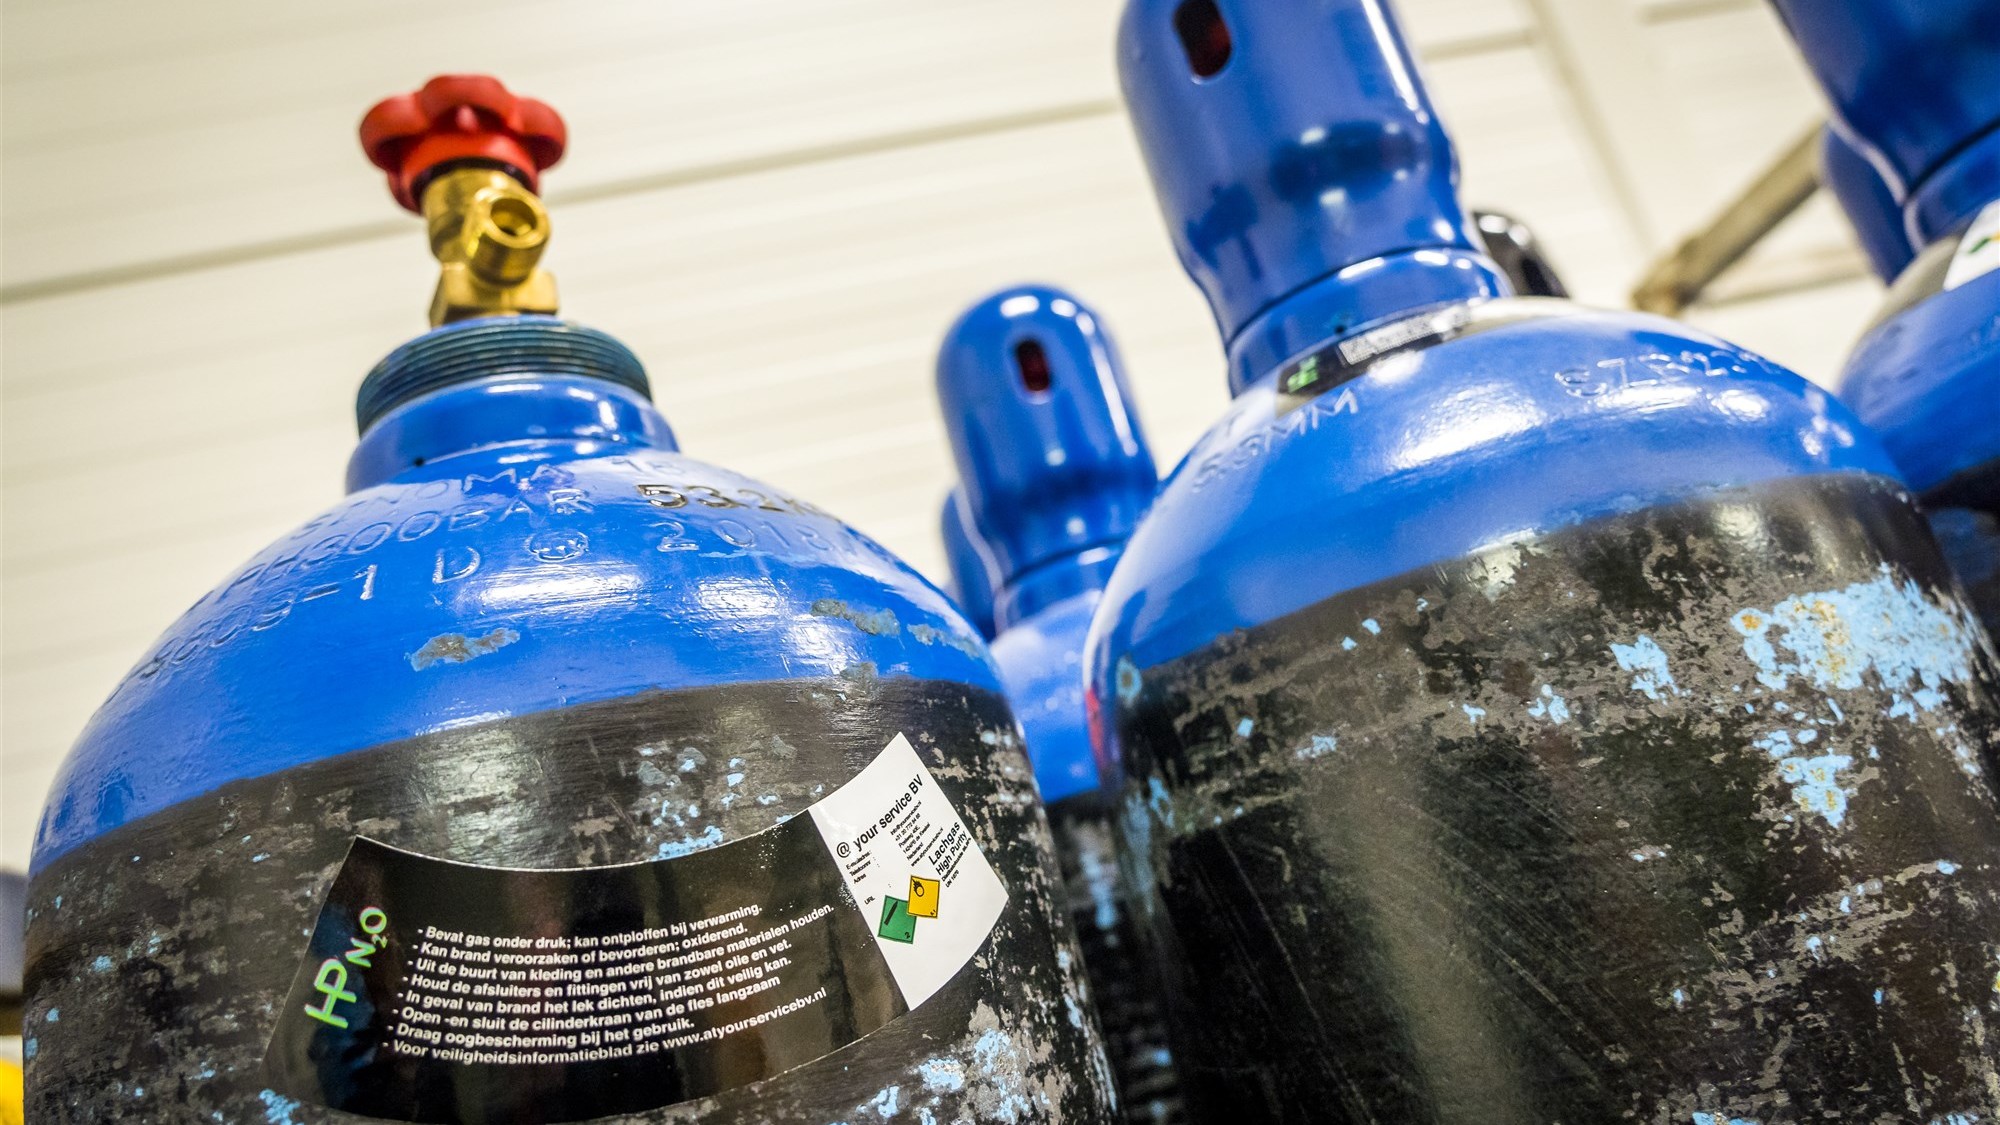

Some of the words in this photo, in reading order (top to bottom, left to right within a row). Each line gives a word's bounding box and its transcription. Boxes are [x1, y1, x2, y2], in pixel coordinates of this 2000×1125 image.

[836, 842, 851, 858] @
[853, 826, 879, 852] your
[879, 792, 913, 829] service
[909, 774, 924, 796] BV
[928, 822, 961, 866] Lachgas
[935, 854, 953, 876] High
[950, 830, 967, 857] Purity
[416, 958, 437, 973] Uit
[438, 962, 457, 976] de
[459, 964, 497, 979] buurt
[500, 969, 526, 981] van
[529, 968, 582, 983] kleding
[584, 967, 604, 979] en
[606, 960, 654, 978] andere
[656, 945, 725, 970] brandbare
[727, 925, 790, 954] materialen
[790, 901, 835, 930] houden.
[421, 942, 447, 958] Kan
[450, 946, 490, 963] brand
[493, 952, 578, 965] veroorzaken
[581, 951, 596, 963] of
[599, 941, 680, 962] bevorderen;
[681, 923, 748, 950] oxiderend.
[426, 926, 463, 944] Bevat
[466, 935, 490, 947] gas
[493, 935, 532, 948] onder
[535, 936, 571, 949] druk;
[574, 935, 599, 947] kan
[601, 927, 668, 946] ontploffen
[671, 922, 687, 936] bij
[689, 903, 763, 931] verwarming.
[904, 931, 911, 939] 2
[406, 990, 421, 1004] In
[423, 994, 463, 1011] geval
[466, 1000, 493, 1013] van
[496, 1000, 541, 1014] brand
[544, 1000, 568, 1013] het
[571, 998, 594, 1012] lek
[597, 993, 657, 1011] dichten,
[660, 983, 704, 1001] indien
[706, 976, 725, 991] dit
[726, 965, 764, 986] veilig
[765, 956, 792, 973] kan.
[411, 974, 450, 991] Houd
[452, 980, 471, 995] de
[473, 982, 541, 997] afsluiters
[544, 986, 563, 997] en
[566, 981, 627, 998] fittingen
[629, 975, 653, 991] vrij
[655, 971, 681, 986] van
[684, 960, 723, 980] zowel
[725, 954, 750, 971] olie
[752, 948, 768, 962] en
[769, 938, 792, 955] vet.
[393, 1039, 428, 1057] Voor
[432, 1043, 633, 1065] veiligheidsinformatieblad
[636, 1042, 660, 1055] zie
[662, 986, 827, 1050] www.atyourservicebv.nl
[401, 1007, 441, 1024] Open
[472, 1015, 506, 1030] sluit
[509, 1017, 529, 1031] de
[532, 1012, 632, 1031] cilinderkraan
[634, 1008, 663, 1022] van
[665, 1001, 685, 1016] de
[687, 996, 714, 1013] fles
[716, 976, 780, 1005] langzaam
[397, 1023, 442, 1043] Draag
[444, 1031, 577, 1048] oogbescherming
[581, 1030, 601, 1047] bij
[604, 1027, 629, 1043] het
[633, 1018, 695, 1041] gebruik.
